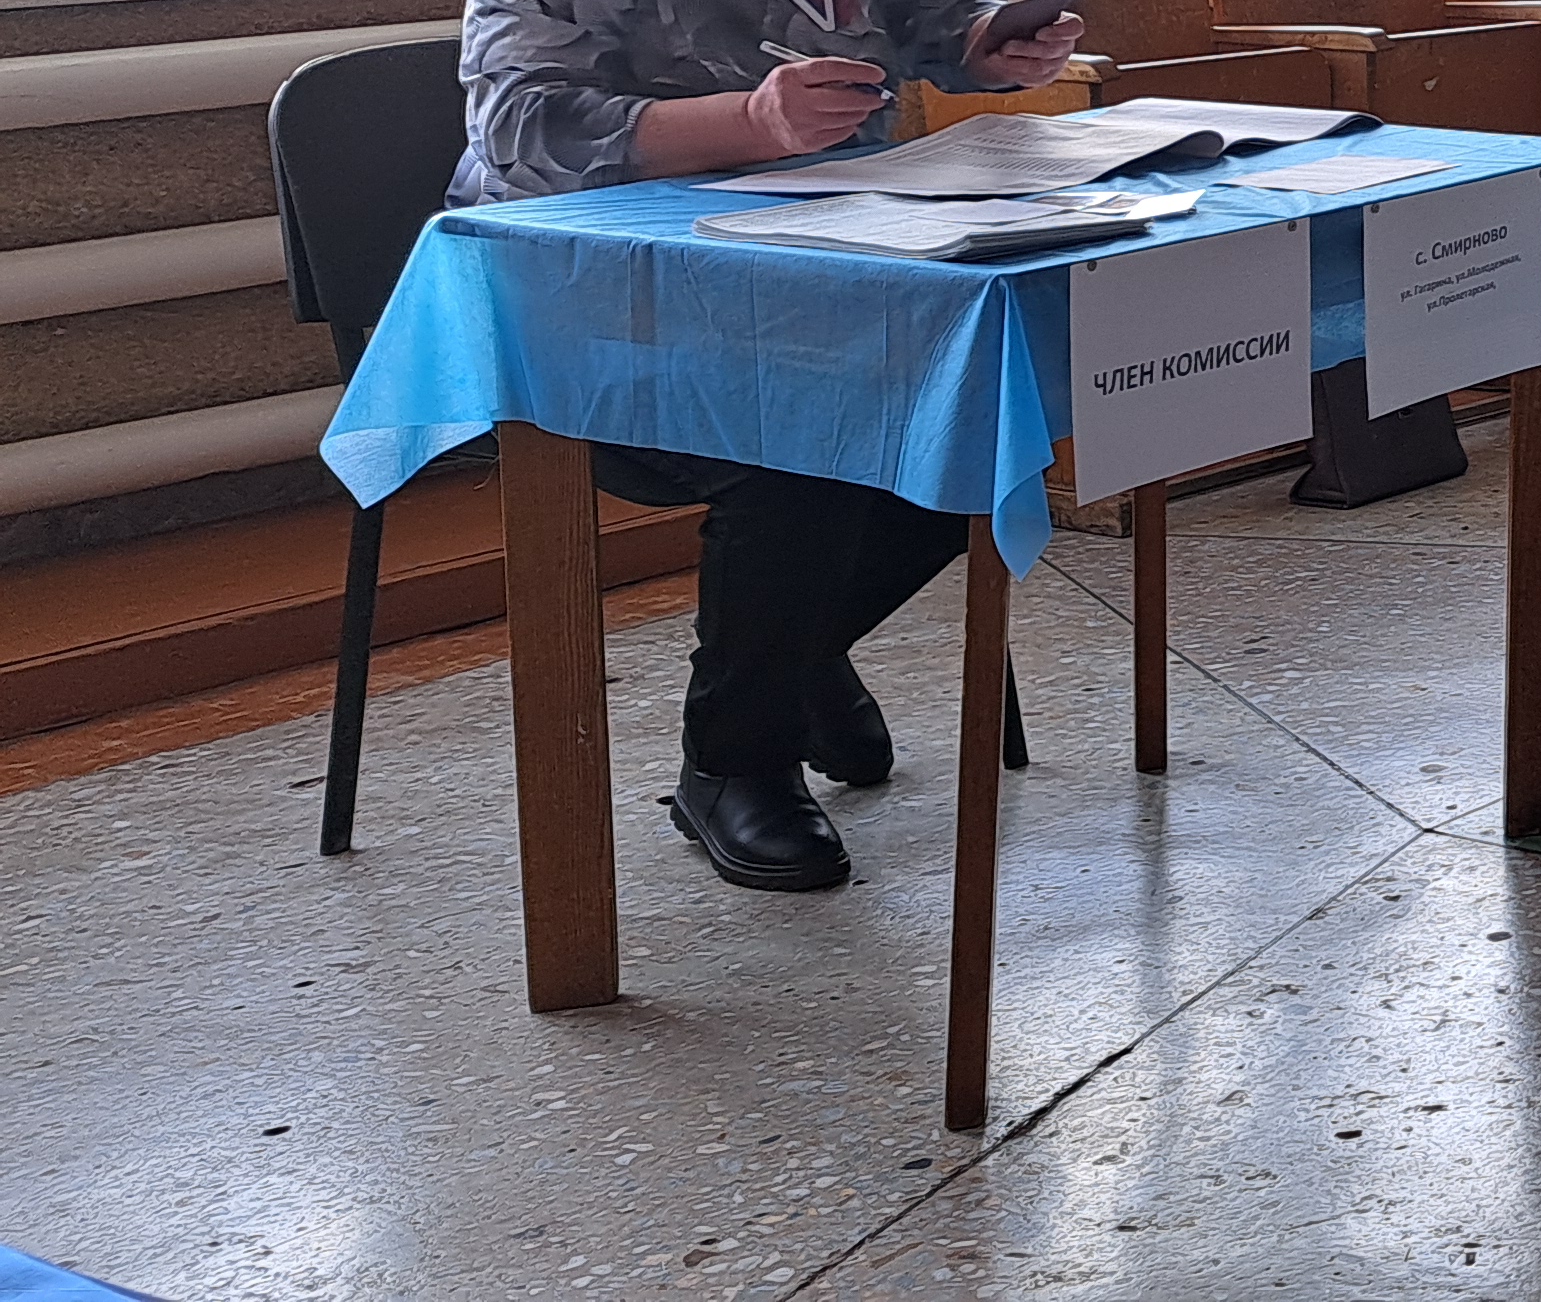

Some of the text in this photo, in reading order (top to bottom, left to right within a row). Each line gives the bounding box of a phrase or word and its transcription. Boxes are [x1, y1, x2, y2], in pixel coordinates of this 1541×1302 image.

[1415, 225, 1508, 265] с. Смирново
[1094, 329, 1291, 396] ЧЛЕН КОМИССИИ
